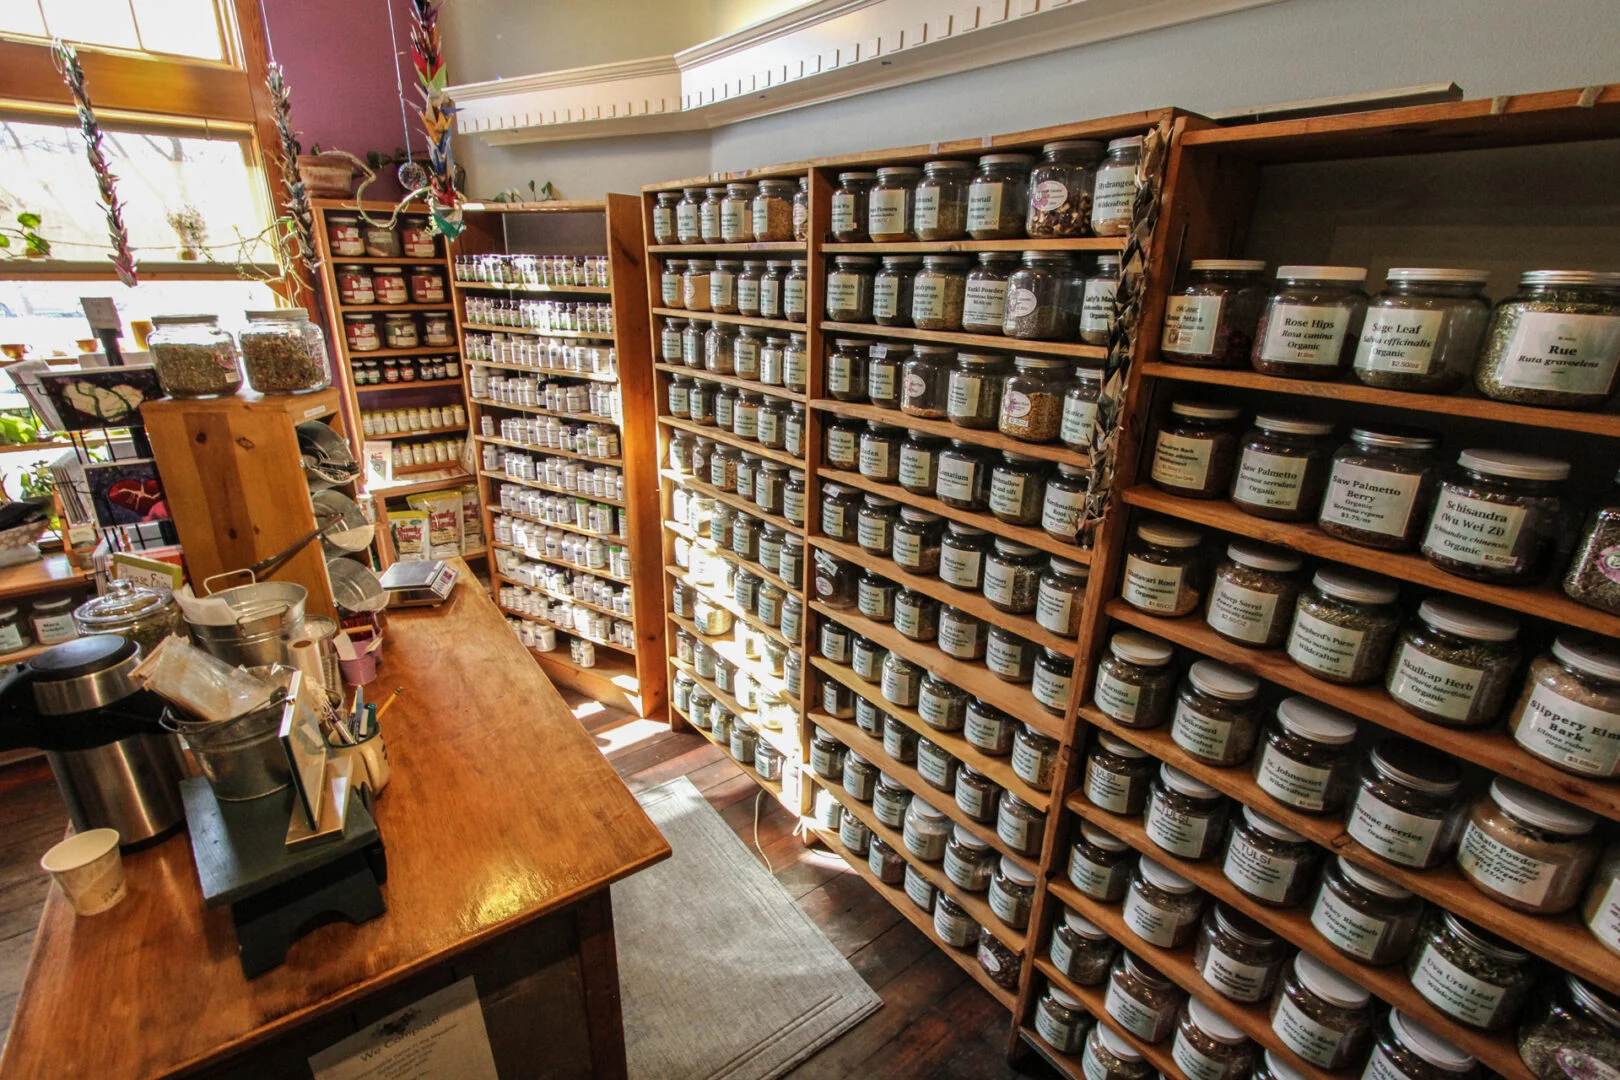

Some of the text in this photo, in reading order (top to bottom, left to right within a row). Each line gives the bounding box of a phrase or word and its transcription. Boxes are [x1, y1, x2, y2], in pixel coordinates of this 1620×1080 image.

[1284, 317, 1335, 330] Rose Hips
[1396, 324, 1422, 334] Leaf
[1281, 330, 1333, 341] Rosa canina
[1384, 336, 1432, 349] officinalis
[1287, 340, 1321, 351] Organic
[1372, 347, 1406, 358] Organic
[1548, 344, 1577, 356] Rue
[1518, 354, 1542, 364] Ruta
[1242, 462, 1297, 480] Saw Palmetto
[1249, 485, 1277, 496] Organic
[1332, 474, 1401, 496] Saw Palmetto
[1345, 499, 1373, 511] Organic
[1346, 489, 1376, 504] Berry
[1446, 500, 1508, 524] Schisandra
[1441, 511, 1459, 528] (Wu
[1461, 516, 1486, 533] Wei
[1443, 538, 1482, 557] Organic
[1157, 576, 1177, 587] Root
[1332, 636, 1357, 649] Purse
[1298, 642, 1341, 665] Wildcrafted
[1402, 658, 1475, 693] Skullcap Herb
[1410, 685, 1447, 705] Organic
[1530, 699, 1620, 742] Slippery Elm
[1548, 723, 1585, 743] Bark
[1276, 765, 1323, 787] Johnswort
[1384, 823, 1424, 841] Berries
[1241, 843, 1272, 866] TULSI
[1499, 847, 1540, 869] Powder
[1342, 915, 1379, 938] Rhubarb
[1426, 957, 1496, 1002] Uva Ursi Leaf
[360, 1047, 382, 1062] We
